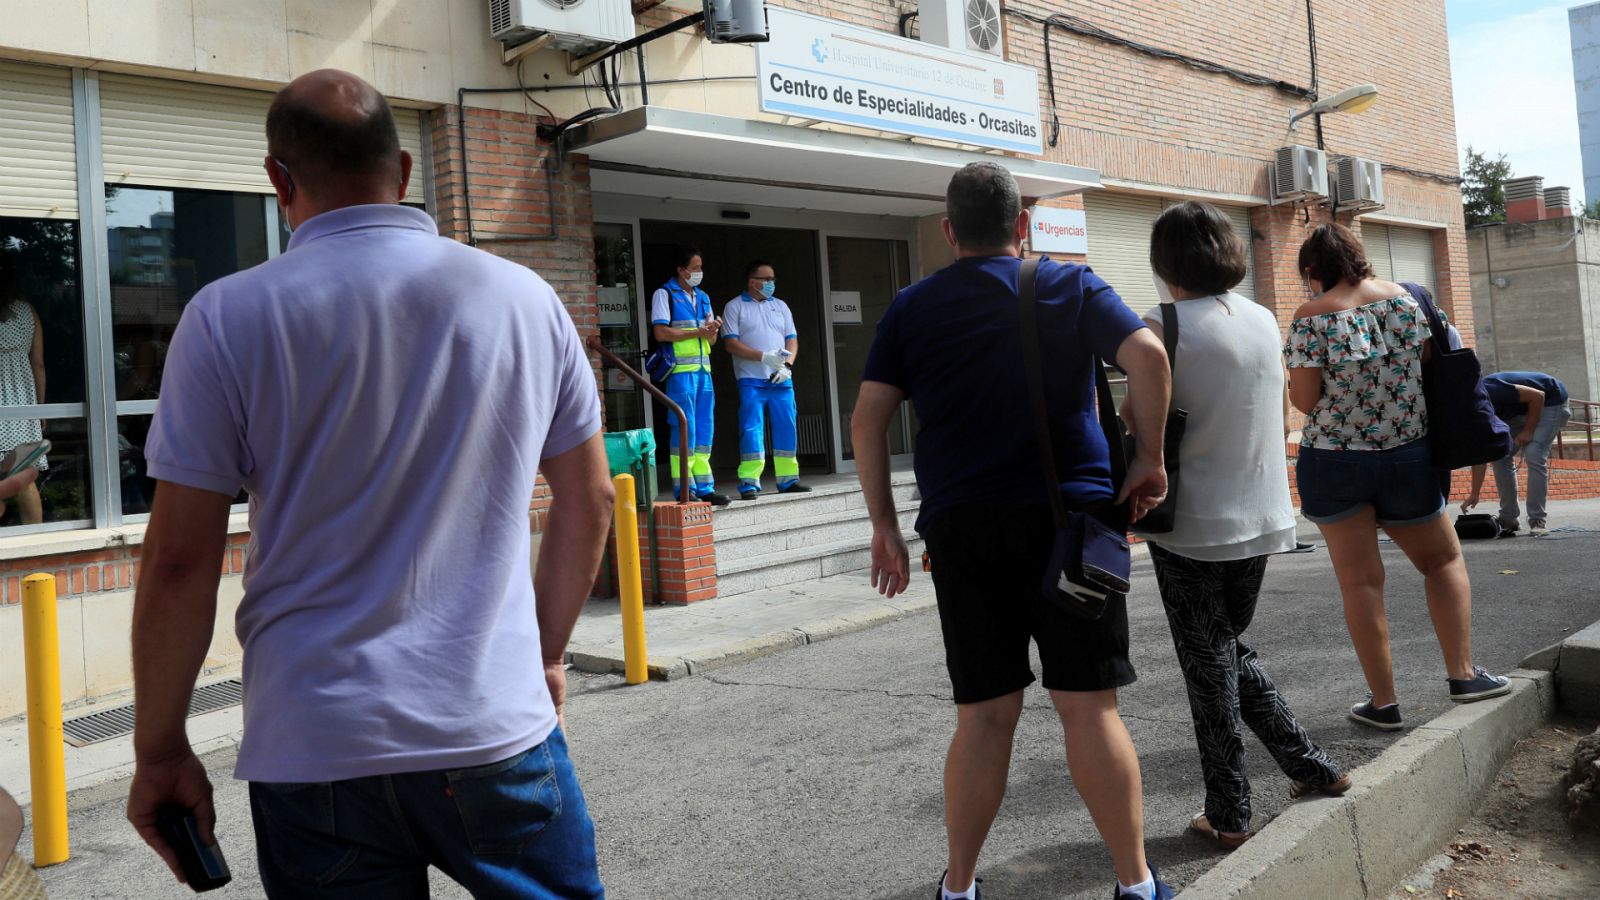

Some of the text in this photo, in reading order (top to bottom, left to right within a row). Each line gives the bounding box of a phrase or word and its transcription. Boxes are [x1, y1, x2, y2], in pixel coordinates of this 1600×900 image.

[833, 48, 987, 91] Hospital Universitario 12 de Octubre
[770, 72, 828, 100] Centro
[833, 85, 853, 105] de
[858, 89, 967, 125] Especialidades
[979, 112, 1037, 137] Orcasitas
[1045, 222, 1085, 238] Urgencias
[597, 303, 629, 312] TRADA
[834, 304, 857, 312] SALIDA
